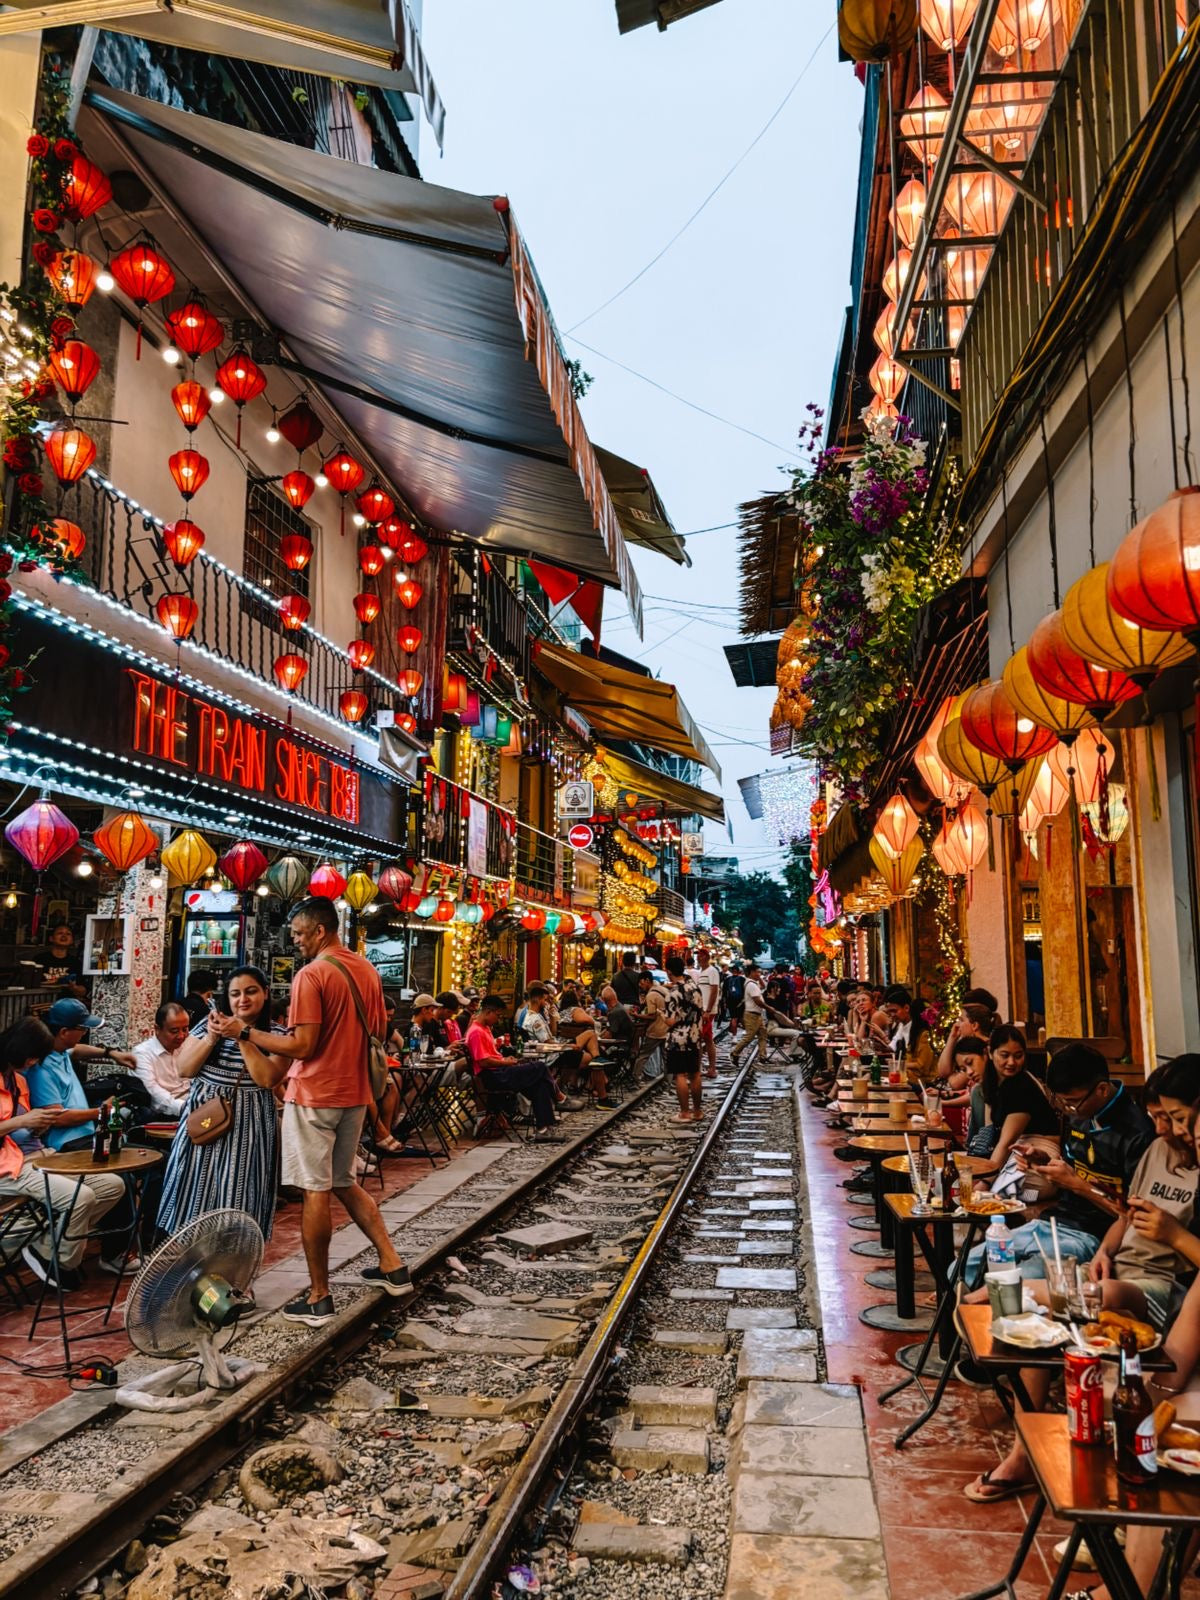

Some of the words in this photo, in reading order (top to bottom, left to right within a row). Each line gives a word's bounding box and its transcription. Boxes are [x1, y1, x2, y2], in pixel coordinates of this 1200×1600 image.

[126, 668, 189, 767] THE
[193, 697, 267, 792] TRAIN
[274, 738, 328, 815] SINCE
